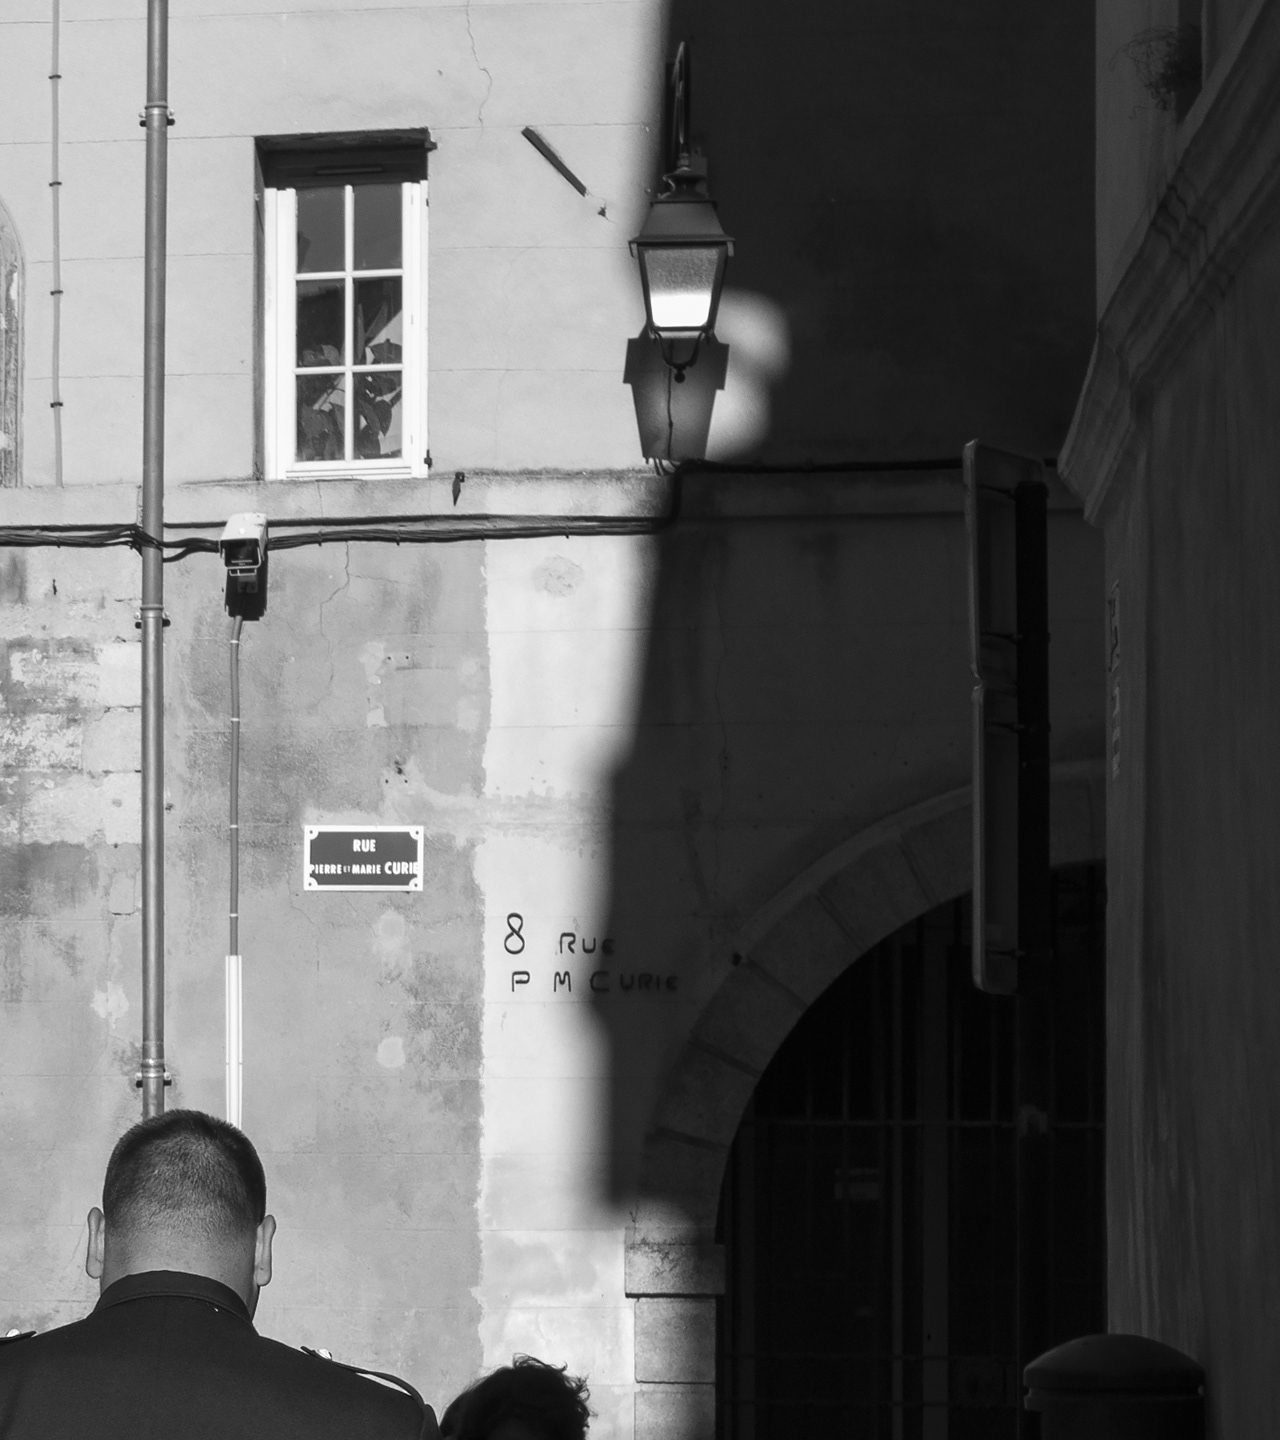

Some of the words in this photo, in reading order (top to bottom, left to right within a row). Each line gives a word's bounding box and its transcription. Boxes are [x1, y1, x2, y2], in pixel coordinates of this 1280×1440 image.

[352, 838, 376, 852] RUE
[309, 863, 342, 875] PIERRE
[351, 863, 382, 875] MARIE
[384, 861, 419, 875] CURIE
[504, 912, 525, 955] 8
[512, 971, 530, 992] P
[554, 971, 571, 992] M
